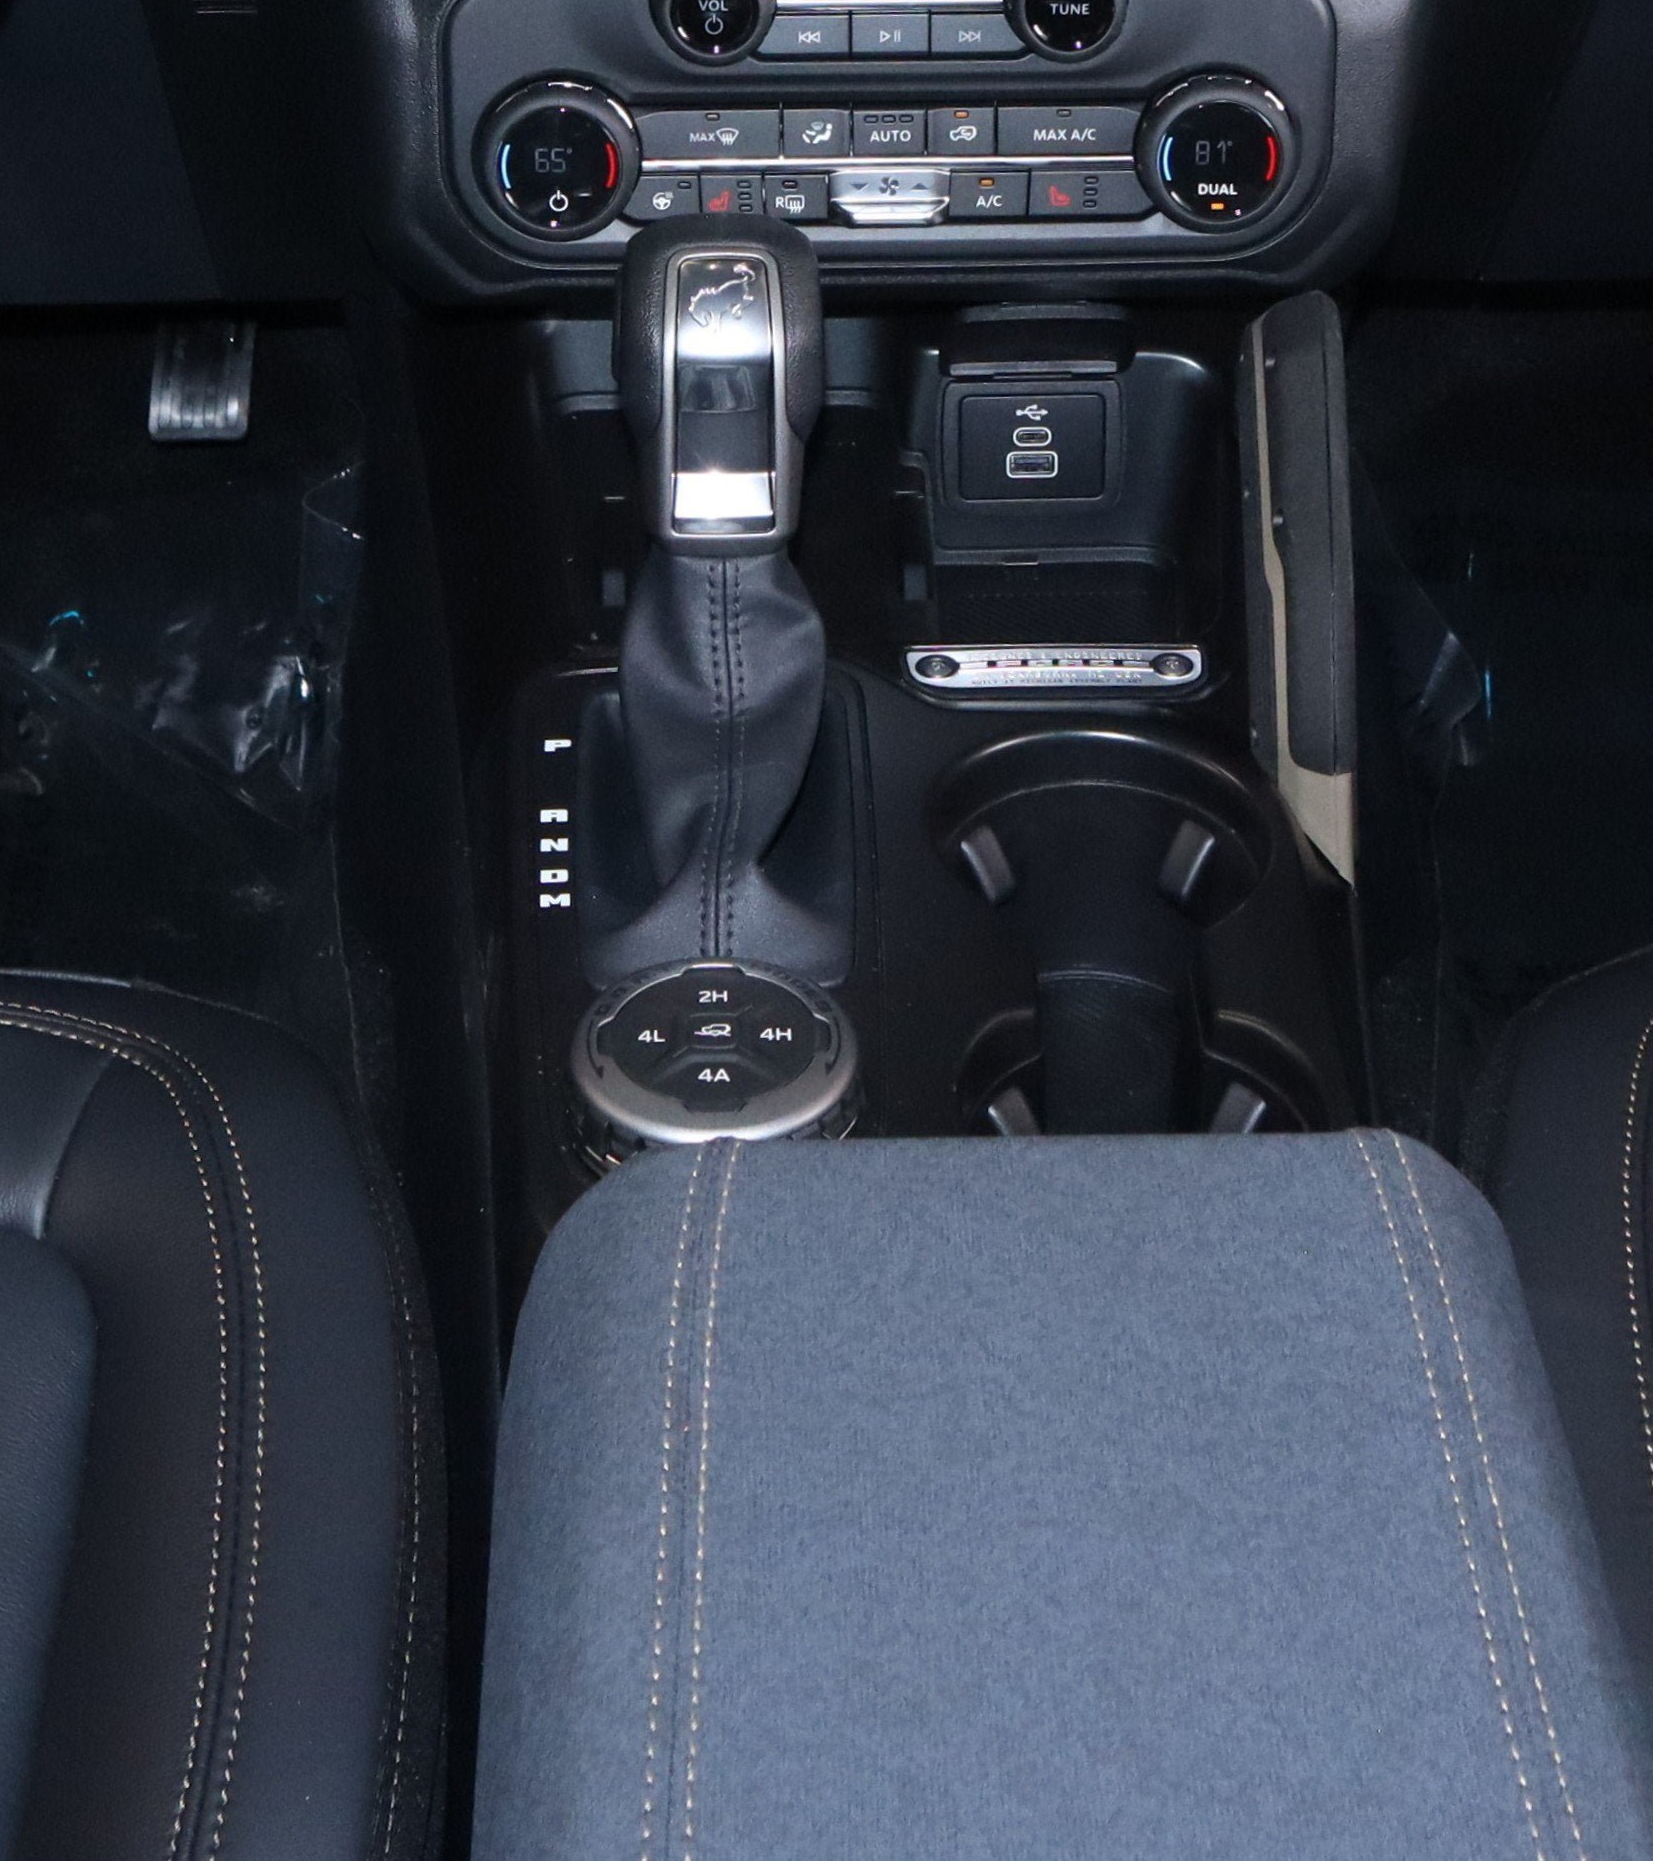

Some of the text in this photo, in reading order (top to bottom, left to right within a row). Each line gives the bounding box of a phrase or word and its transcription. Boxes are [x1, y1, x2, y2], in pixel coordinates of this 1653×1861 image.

[698, 0, 729, 13] VOL
[1050, 2, 1090, 16] TUNE
[690, 132, 716, 143] MAX
[870, 129, 911, 143] AUTO
[1033, 128, 1097, 142] MAX A/C
[1198, 183, 1238, 196] DUAL
[775, 196, 785, 208] R
[976, 195, 1003, 209] A/C
[544, 739, 572, 752] P
[540, 838, 569, 852] N
[540, 869, 569, 883] D
[540, 893, 571, 908] M
[698, 990, 728, 1004] 2H
[638, 1030, 666, 1043] 4L
[760, 1028, 793, 1042] 4H
[697, 1069, 731, 1083] 4A
